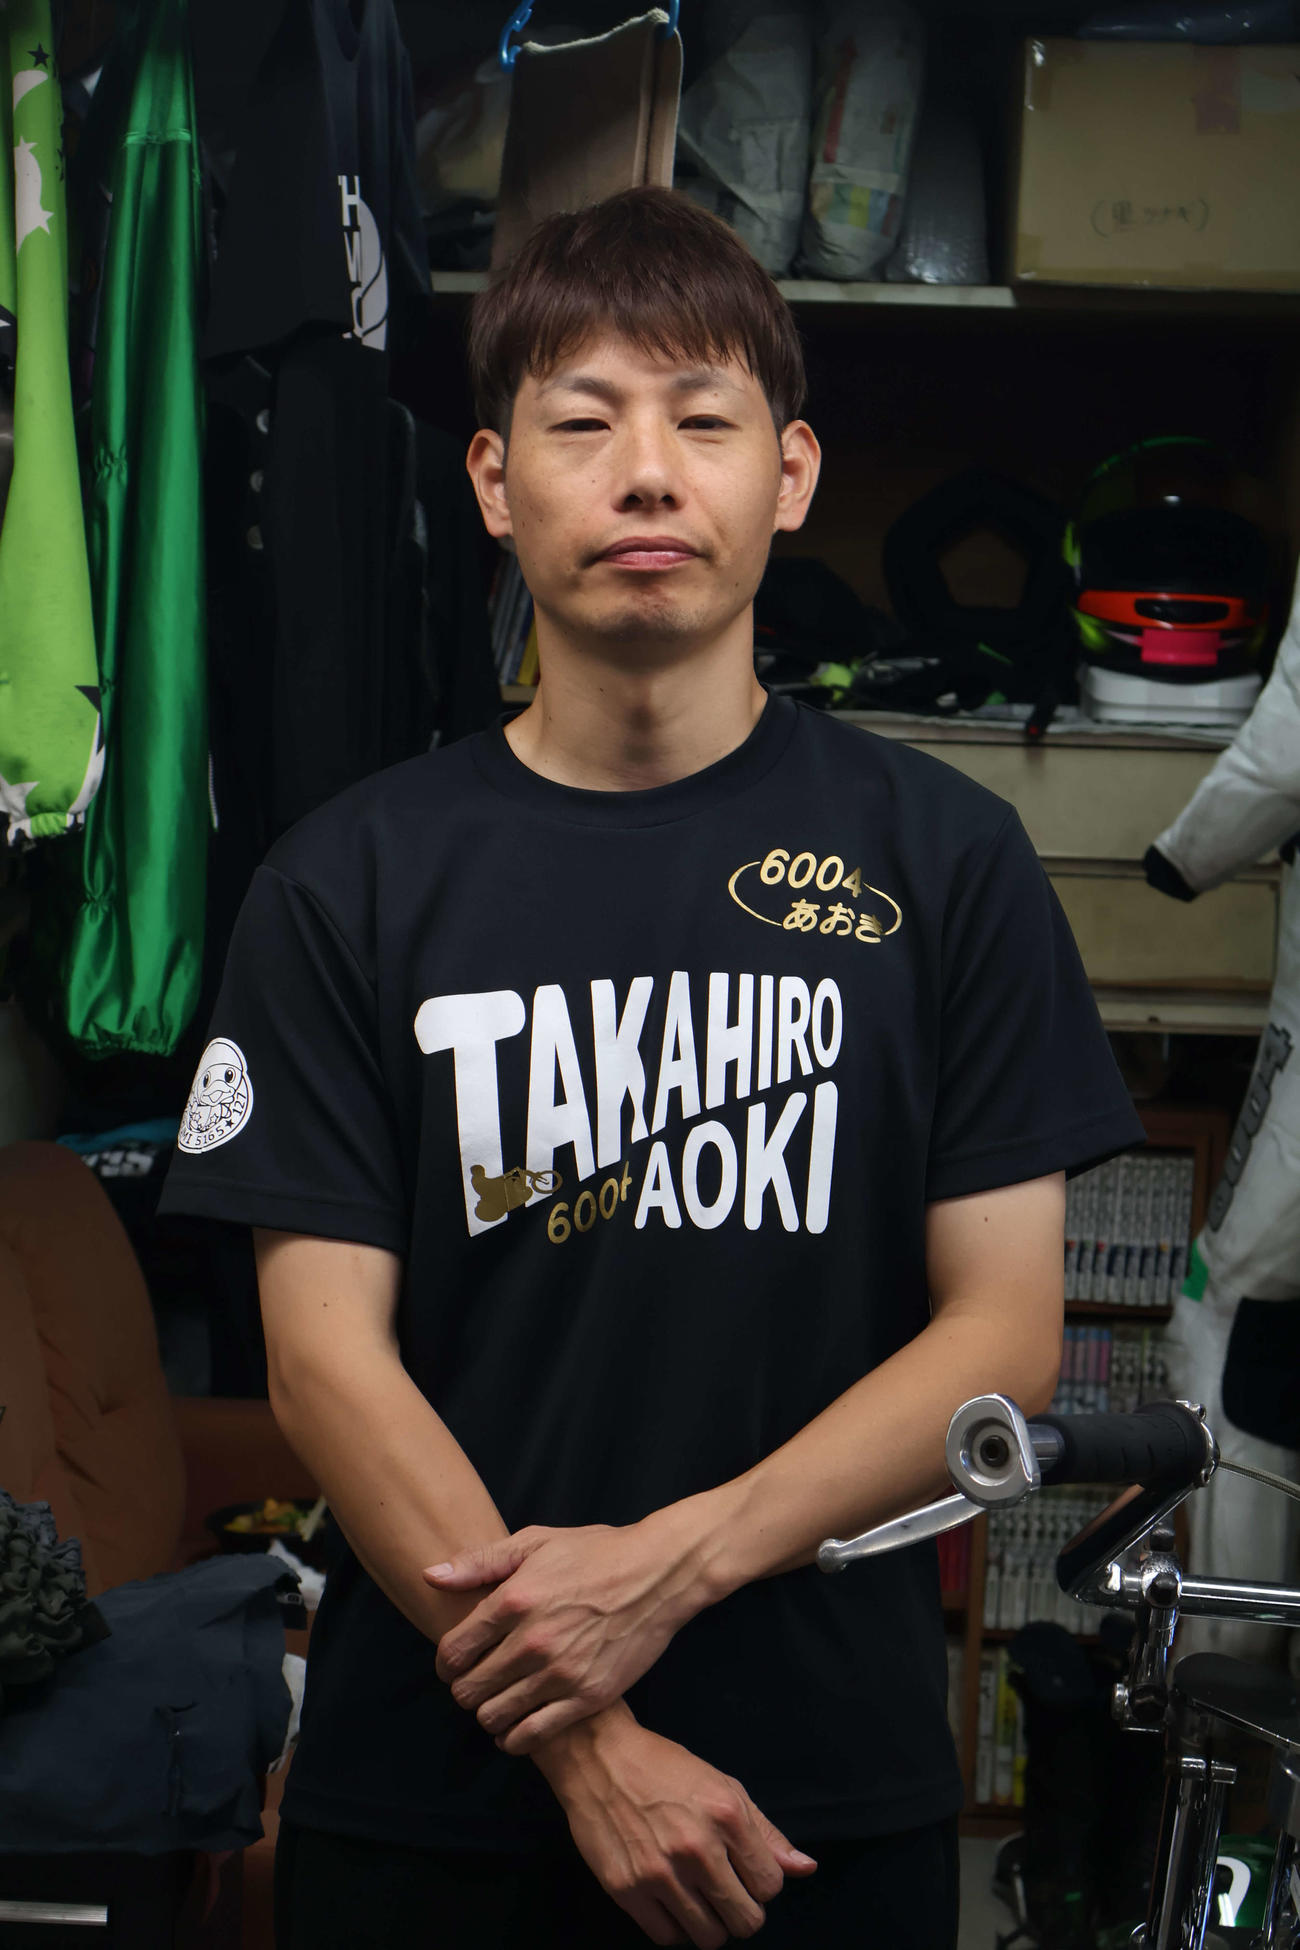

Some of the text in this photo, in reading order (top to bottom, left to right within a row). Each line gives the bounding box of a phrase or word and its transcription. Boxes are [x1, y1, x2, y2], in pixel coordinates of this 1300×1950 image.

[760, 849, 862, 898] 6004
[783, 899, 882, 943] あおき
[414, 971, 843, 1236] TAKAHIRO
[635, 1081, 838, 1233] AOKI
